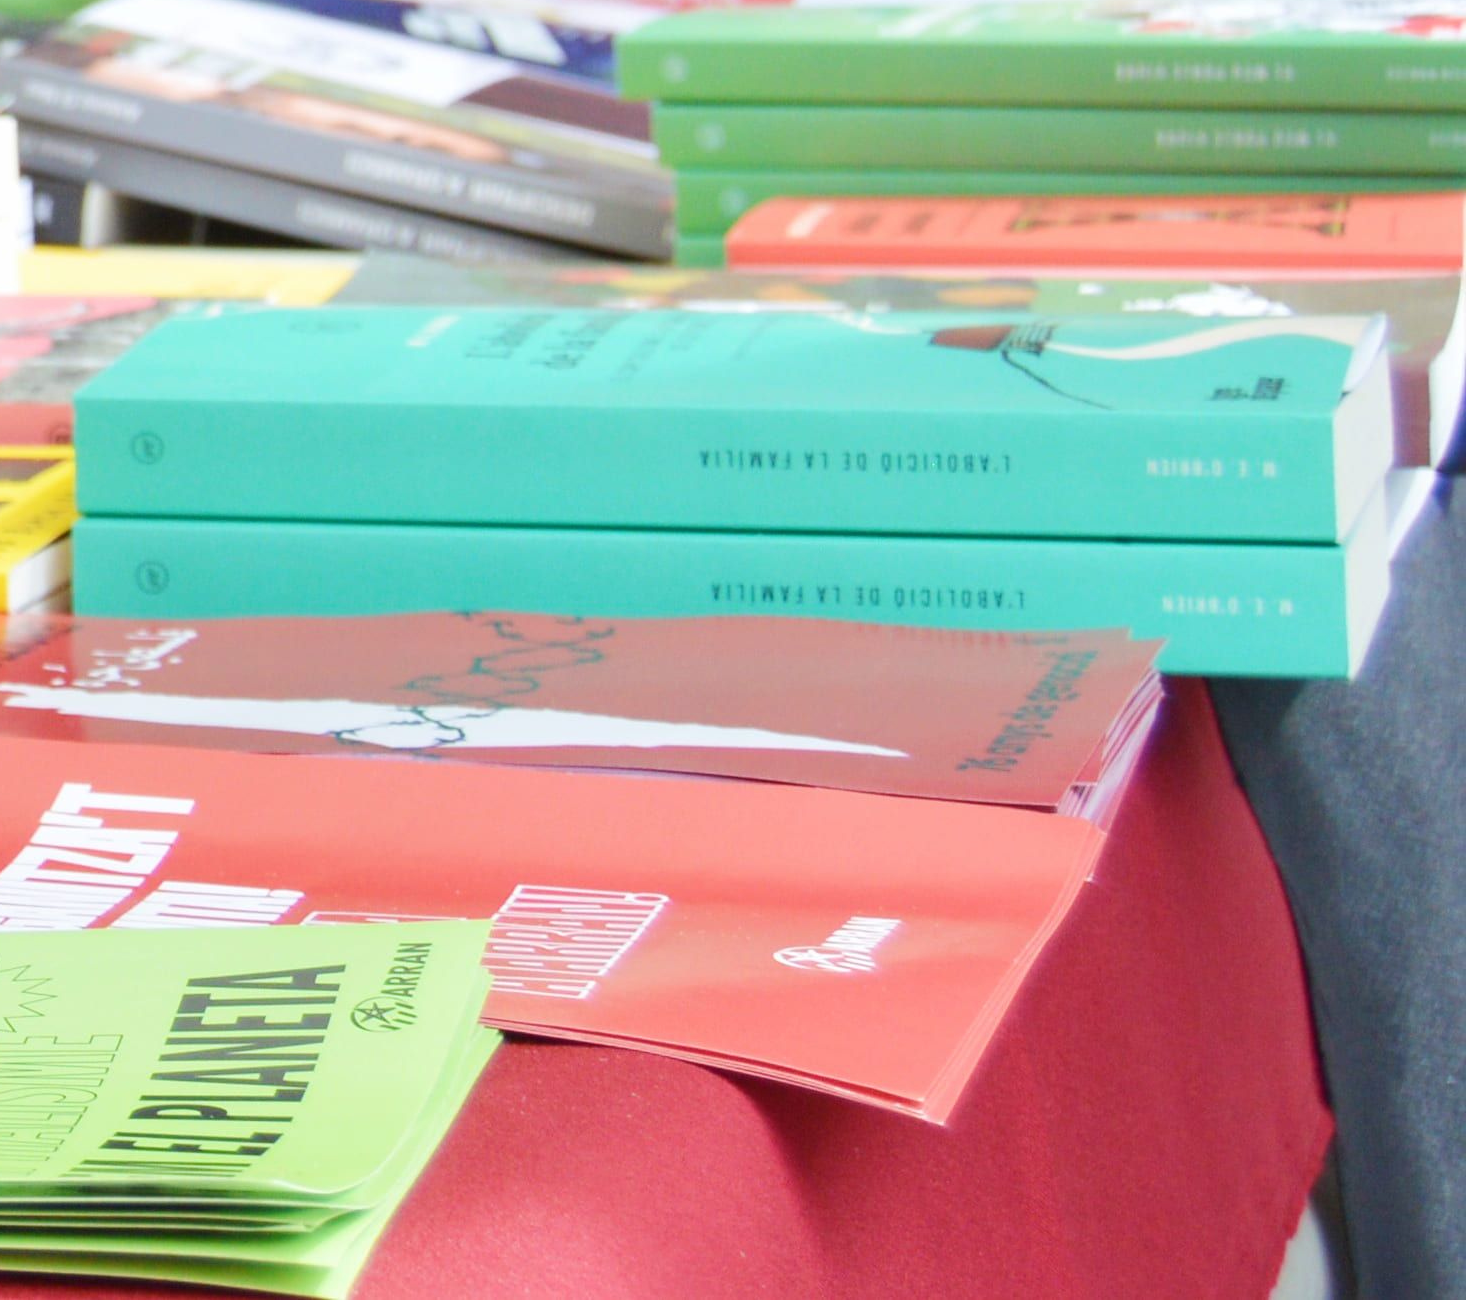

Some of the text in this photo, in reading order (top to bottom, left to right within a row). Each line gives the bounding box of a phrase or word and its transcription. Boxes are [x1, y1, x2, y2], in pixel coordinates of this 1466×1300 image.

[699, 447, 1012, 476] L'ABOLICIÓ DE LA FAMÍLIA
[711, 581, 1026, 610] L'ABOLICIÓ DE LA FAMÍLIA
[380, 942, 434, 998] ARRAN
[128, 963, 347, 1123] PLANETA
[97, 1130, 285, 1157] EL
